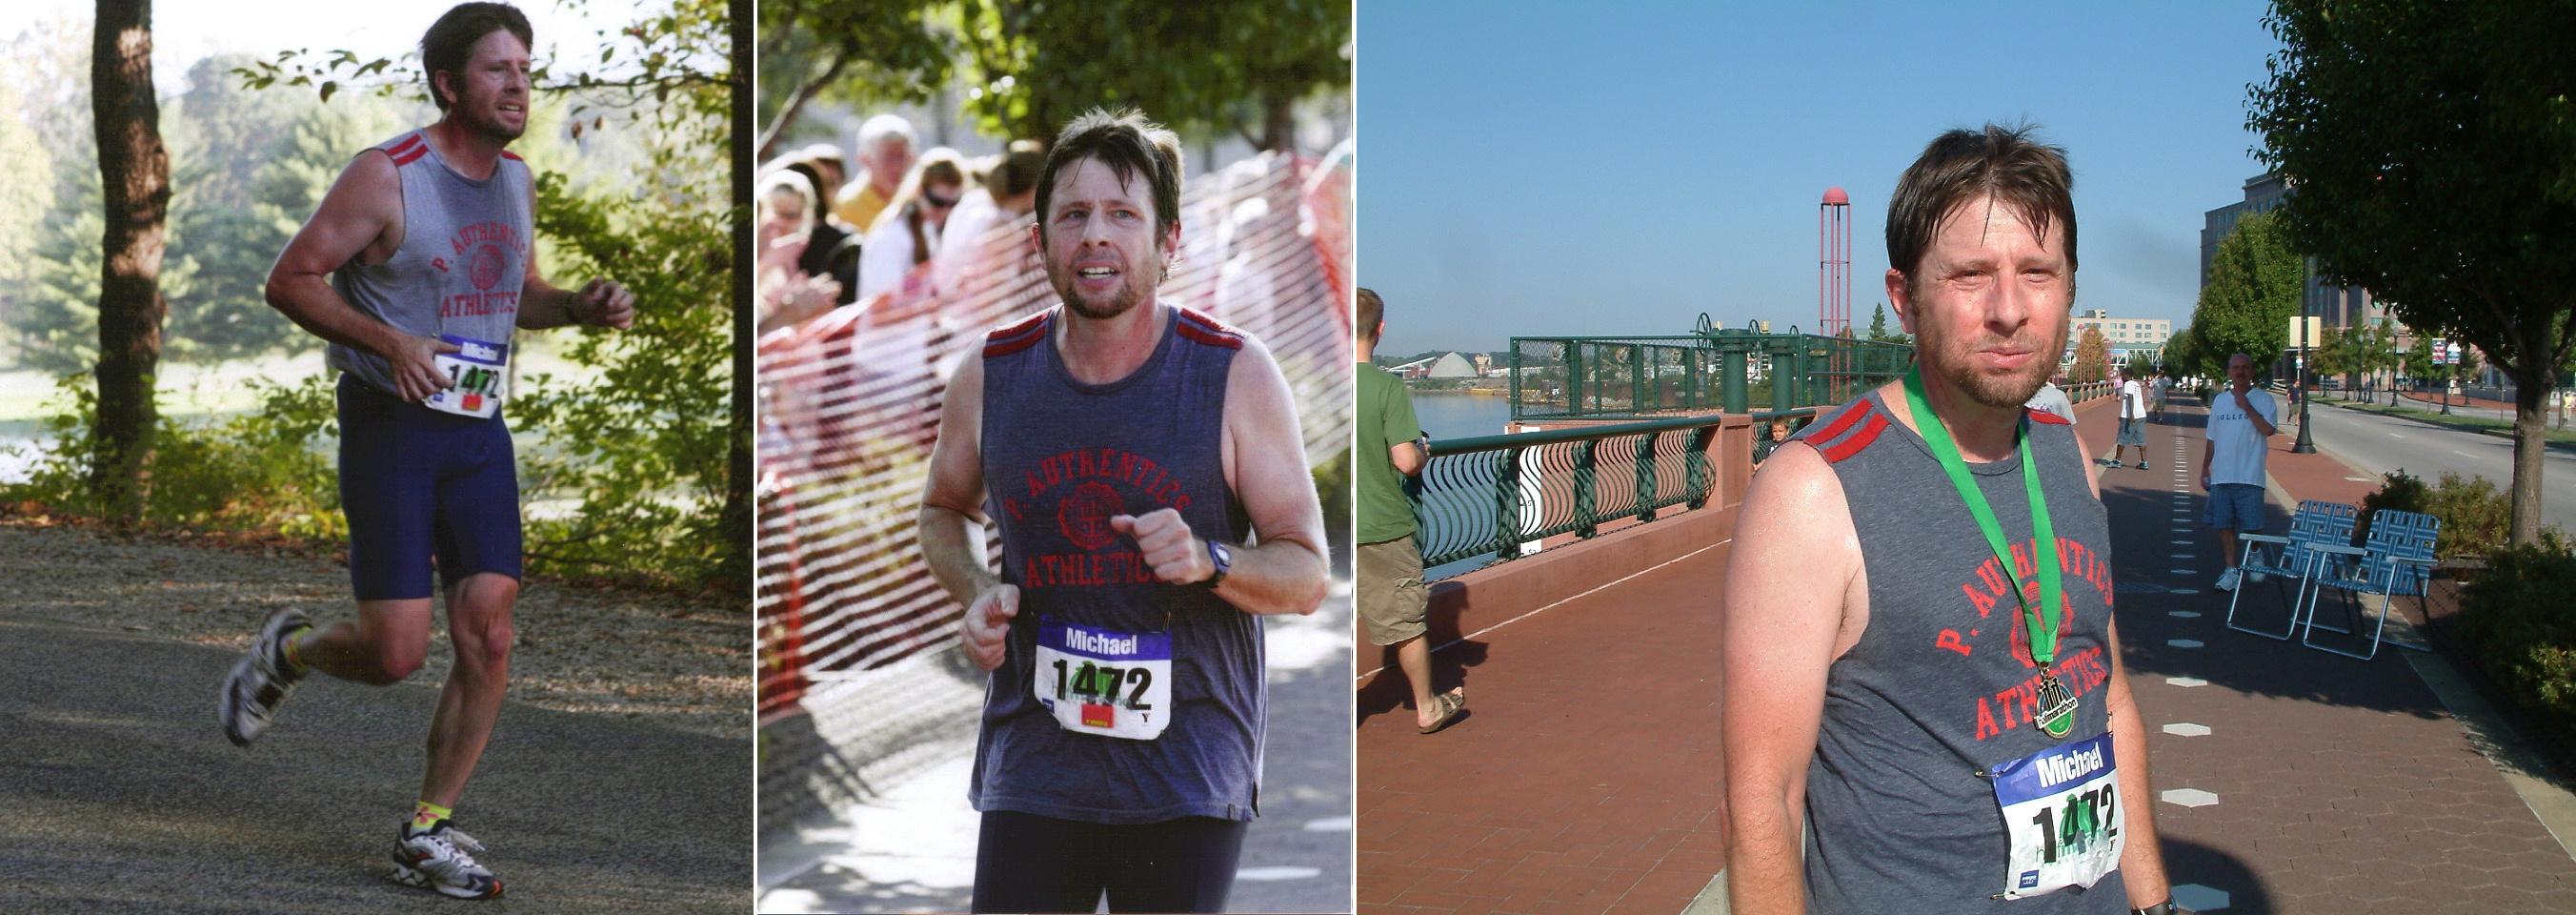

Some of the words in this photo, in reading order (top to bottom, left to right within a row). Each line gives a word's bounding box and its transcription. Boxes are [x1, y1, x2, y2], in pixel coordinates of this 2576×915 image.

[1026, 448, 1193, 513] AUTHENTICS
[1024, 550, 1166, 588] ATHLETIC
[1065, 626, 1138, 656] Michael
[1935, 627, 1981, 657] P.
[1053, 659, 1153, 711] 1472
[1975, 646, 2107, 741] ATHTICS
[2035, 741, 2104, 788] Michael
[2032, 783, 2118, 864] 1472
